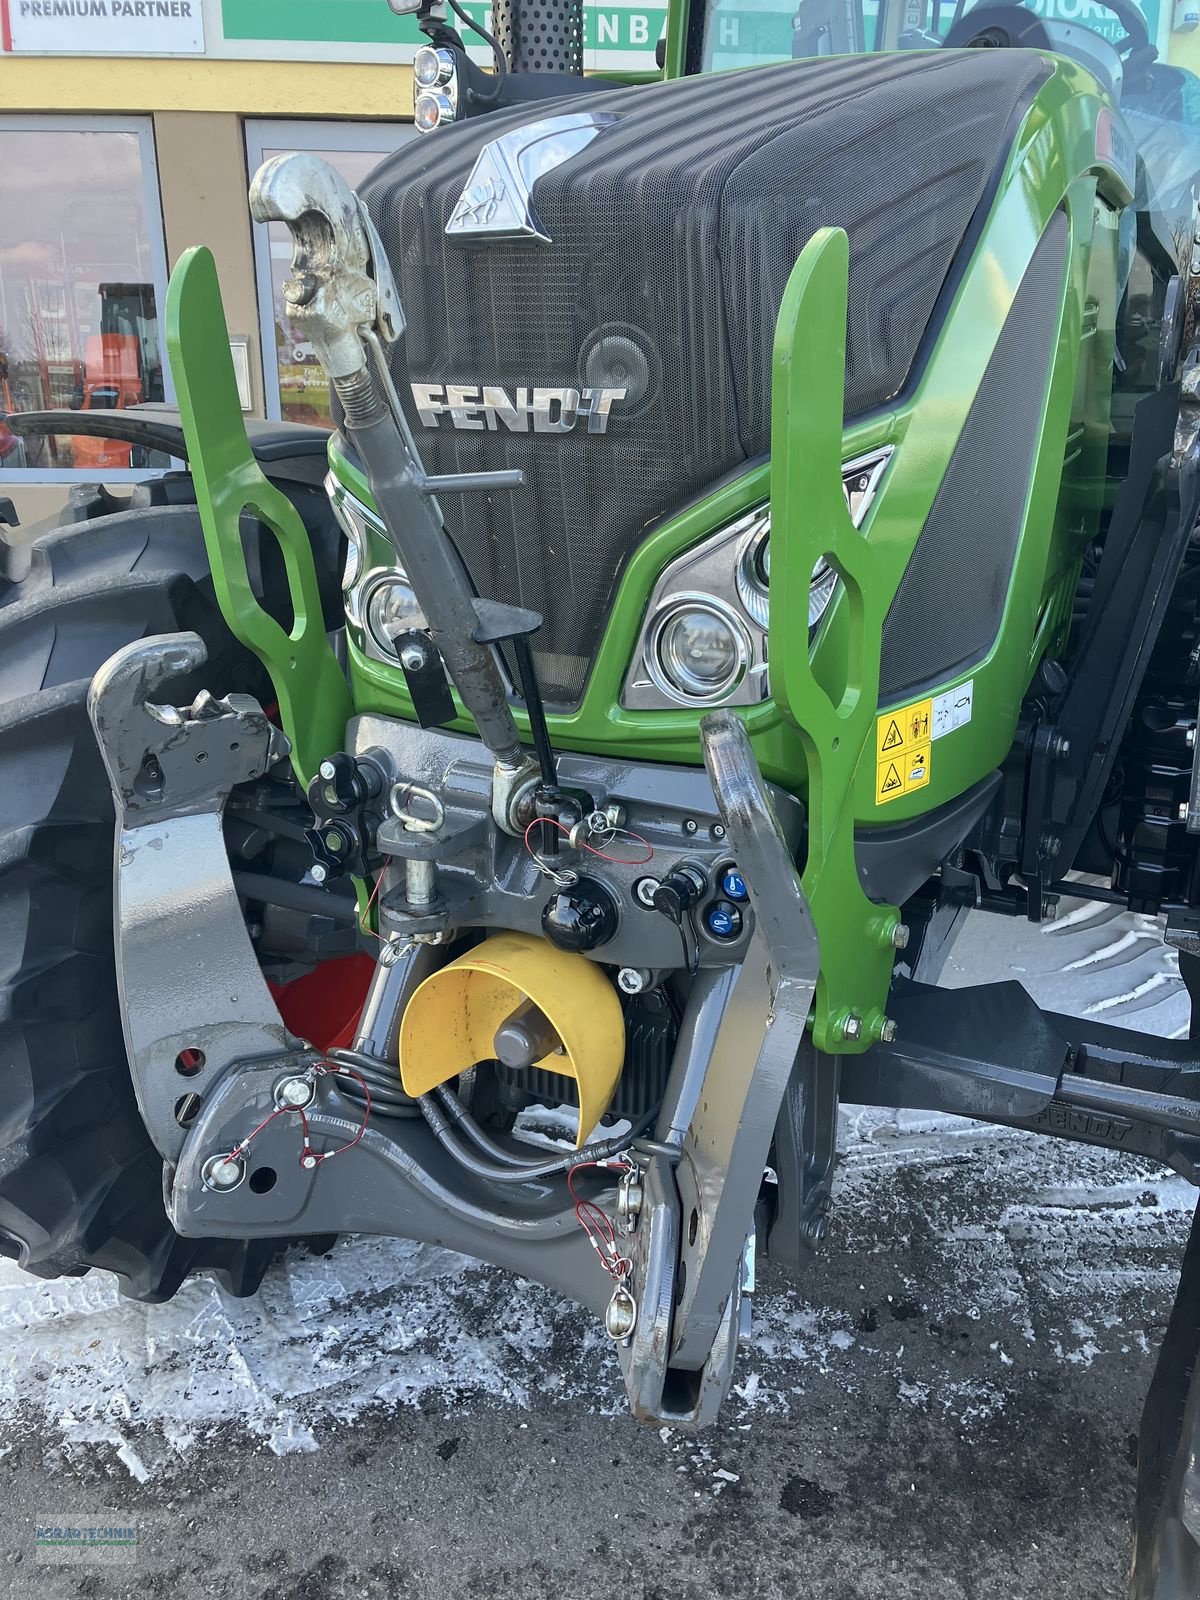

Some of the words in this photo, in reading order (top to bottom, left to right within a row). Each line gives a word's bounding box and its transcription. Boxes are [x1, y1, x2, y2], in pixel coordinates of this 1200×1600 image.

[20, 1, 107, 17] PREMIUM
[112, 1, 192, 17] PARTNER
[410, 383, 627, 434] FENDT
